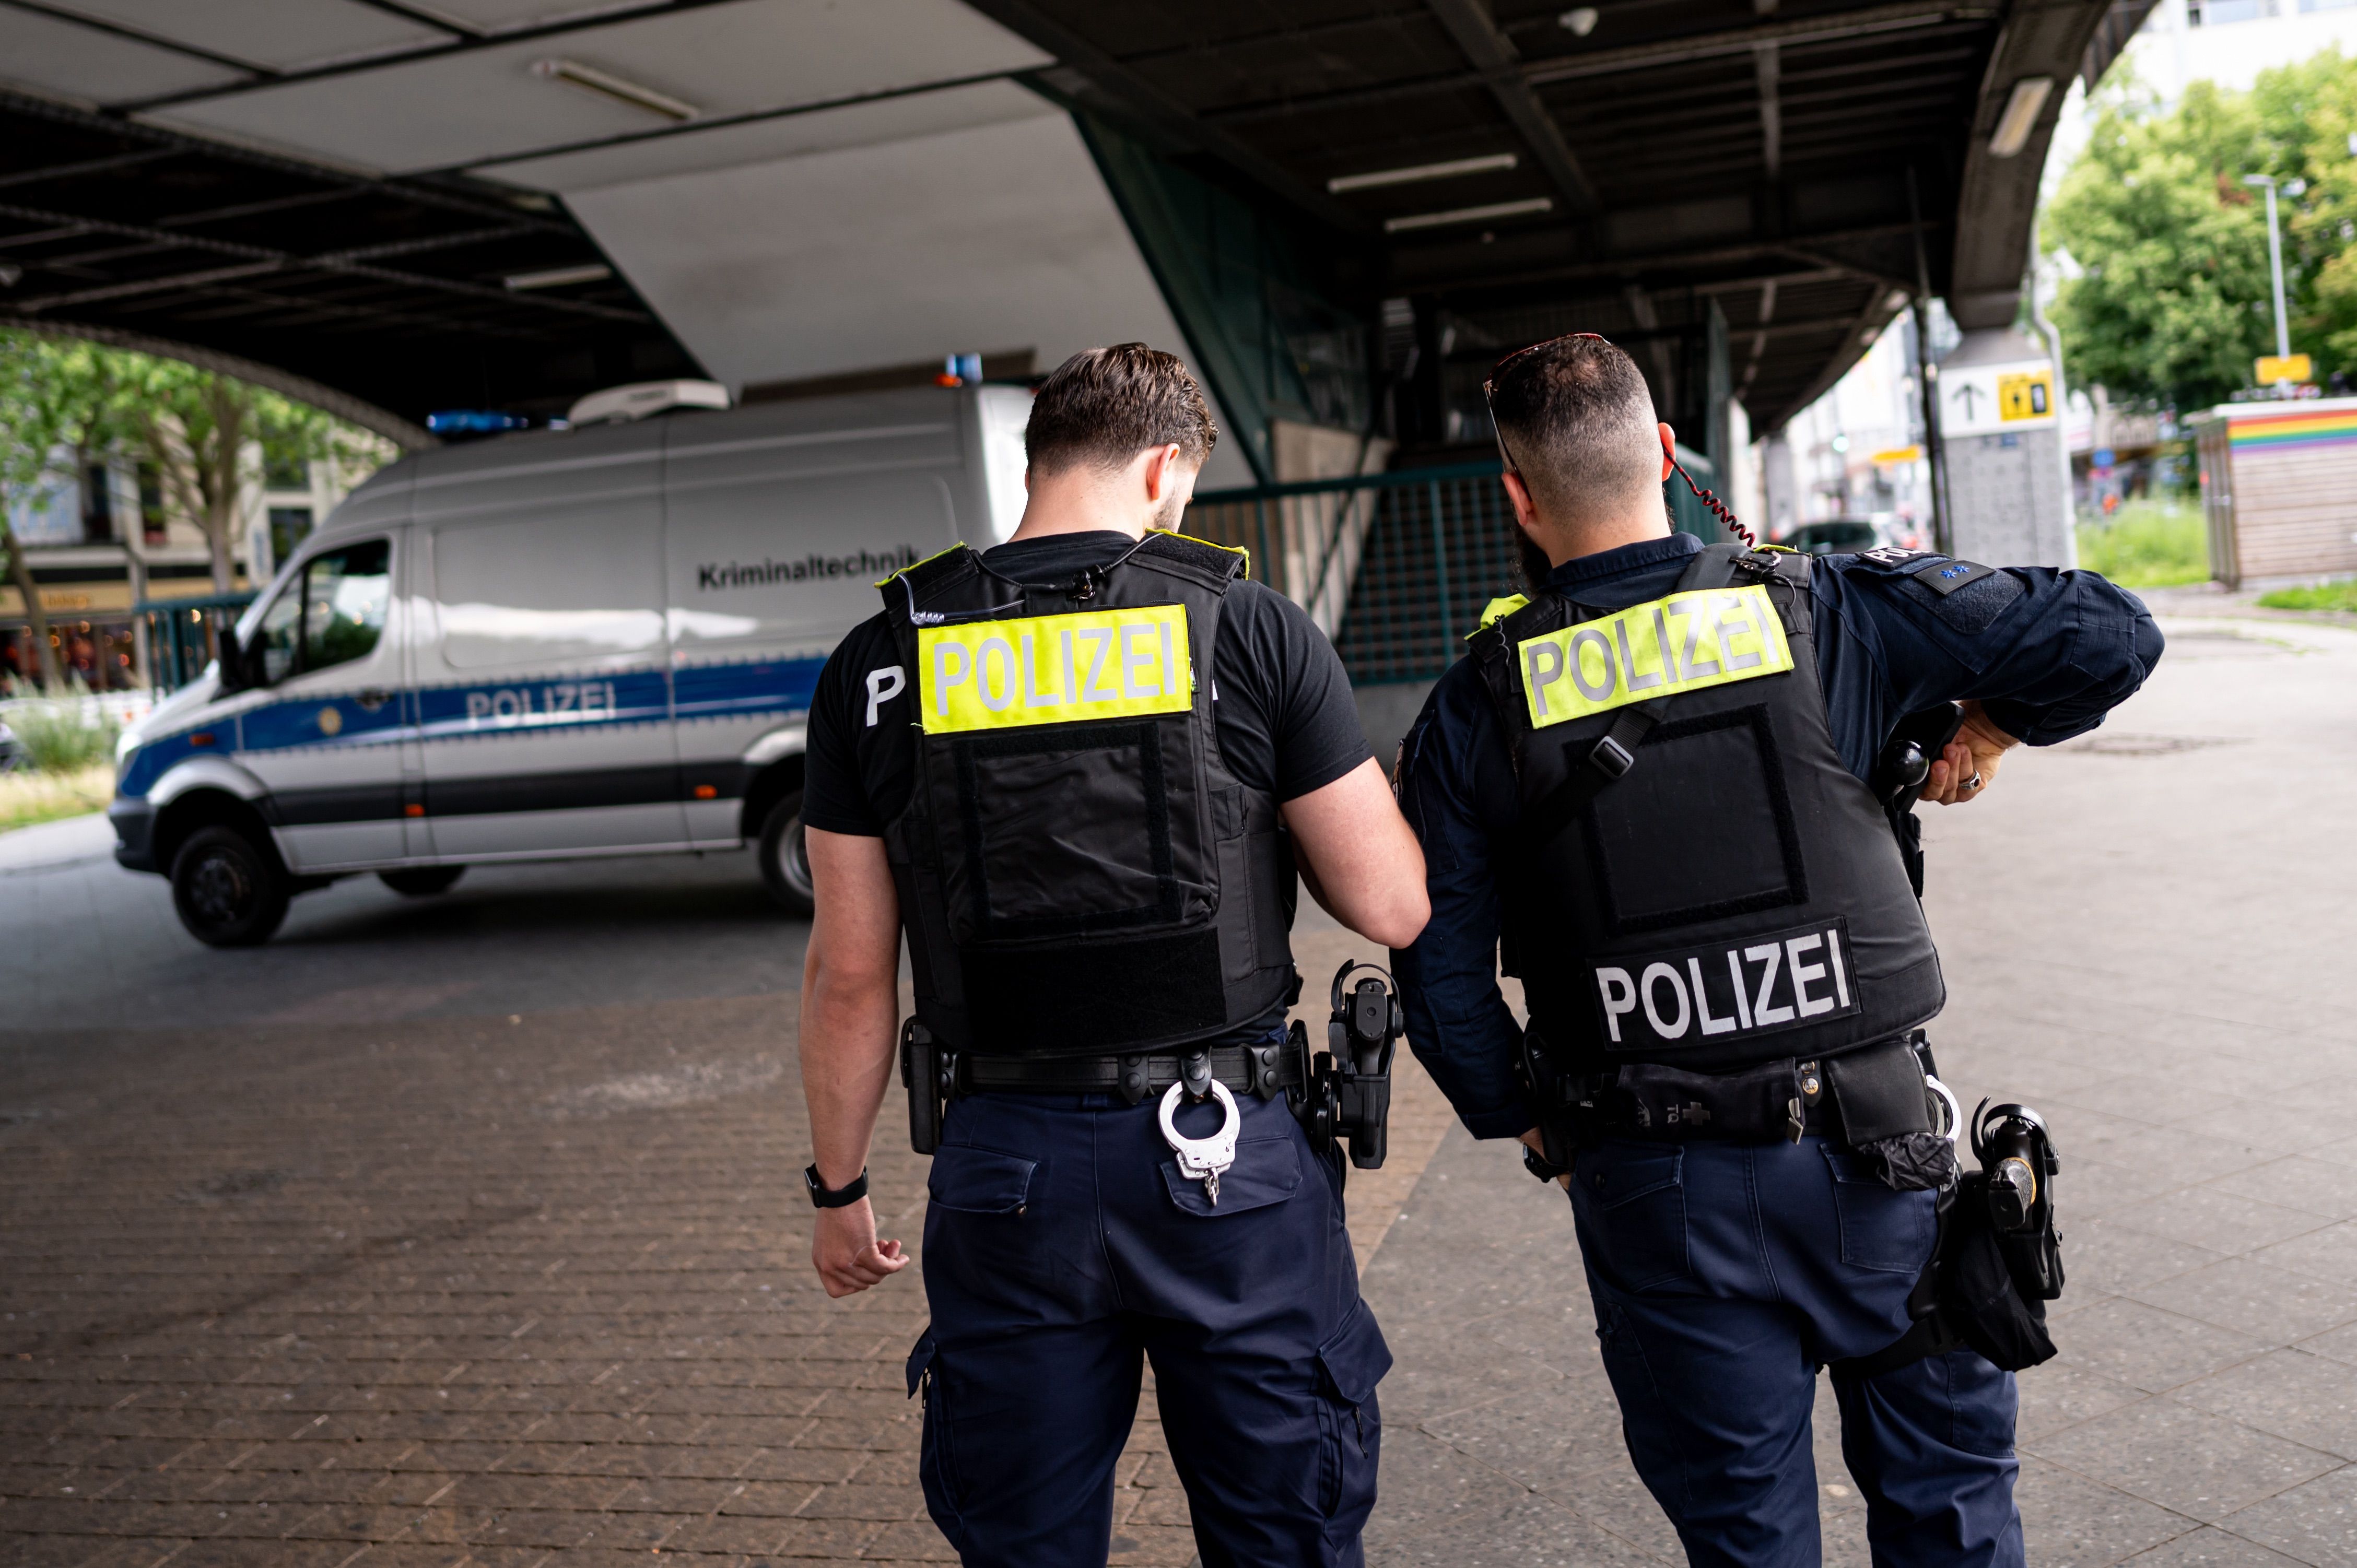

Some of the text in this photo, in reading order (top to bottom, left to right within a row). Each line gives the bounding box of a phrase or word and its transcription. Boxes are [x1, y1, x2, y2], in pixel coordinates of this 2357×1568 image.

[698, 544, 921, 590] Kriminaltechnik
[1864, 547, 1931, 563] PO
[933, 622, 1176, 716] POLIZEI
[1527, 593, 1778, 716] POLIZEI
[466, 682, 616, 728] POLIZEI
[1595, 929, 1850, 1042] POLIZEI
